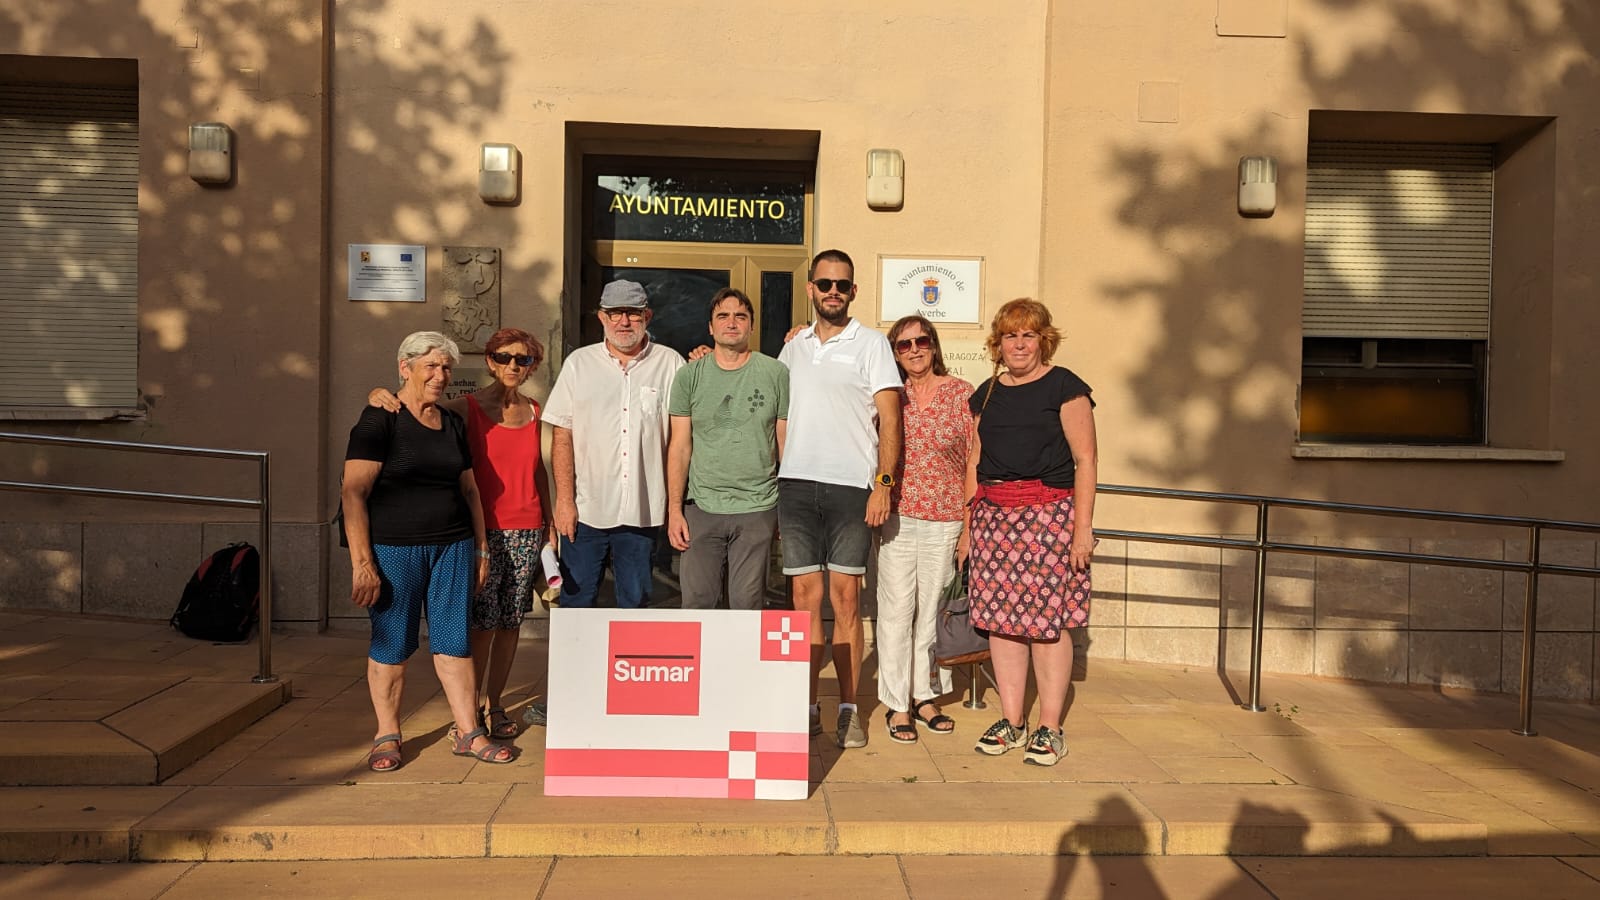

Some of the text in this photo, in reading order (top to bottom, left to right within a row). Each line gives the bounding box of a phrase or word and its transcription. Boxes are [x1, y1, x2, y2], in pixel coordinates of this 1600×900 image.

[609, 194, 785, 220] AYUNTAMIENTO
[897, 264, 965, 291] Ayuntamiento de
[943, 352, 986, 361] ARAGOZA
[614, 660, 694, 682] Sumar
